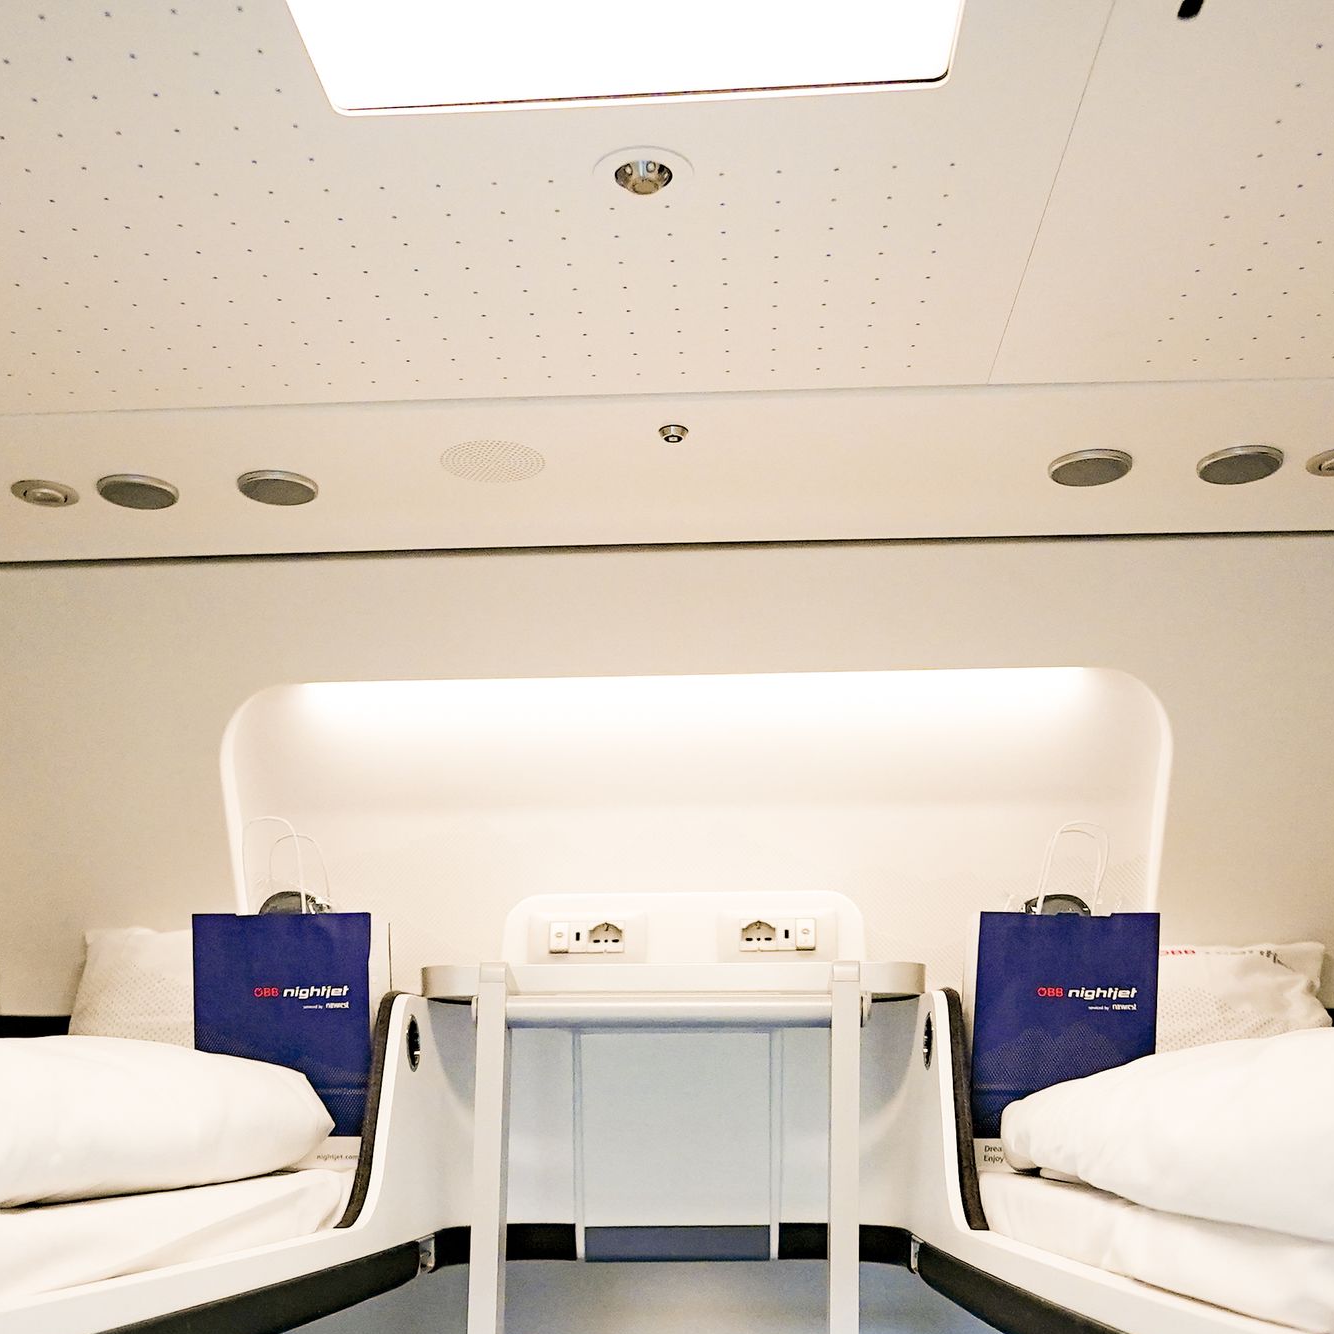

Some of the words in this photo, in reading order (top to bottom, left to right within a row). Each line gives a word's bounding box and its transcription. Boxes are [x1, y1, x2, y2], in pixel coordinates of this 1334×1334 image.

[283, 985, 349, 1000] nightjet
[1068, 986, 1137, 1001] nightjet
[983, 1155, 1003, 1163] Enjoy
